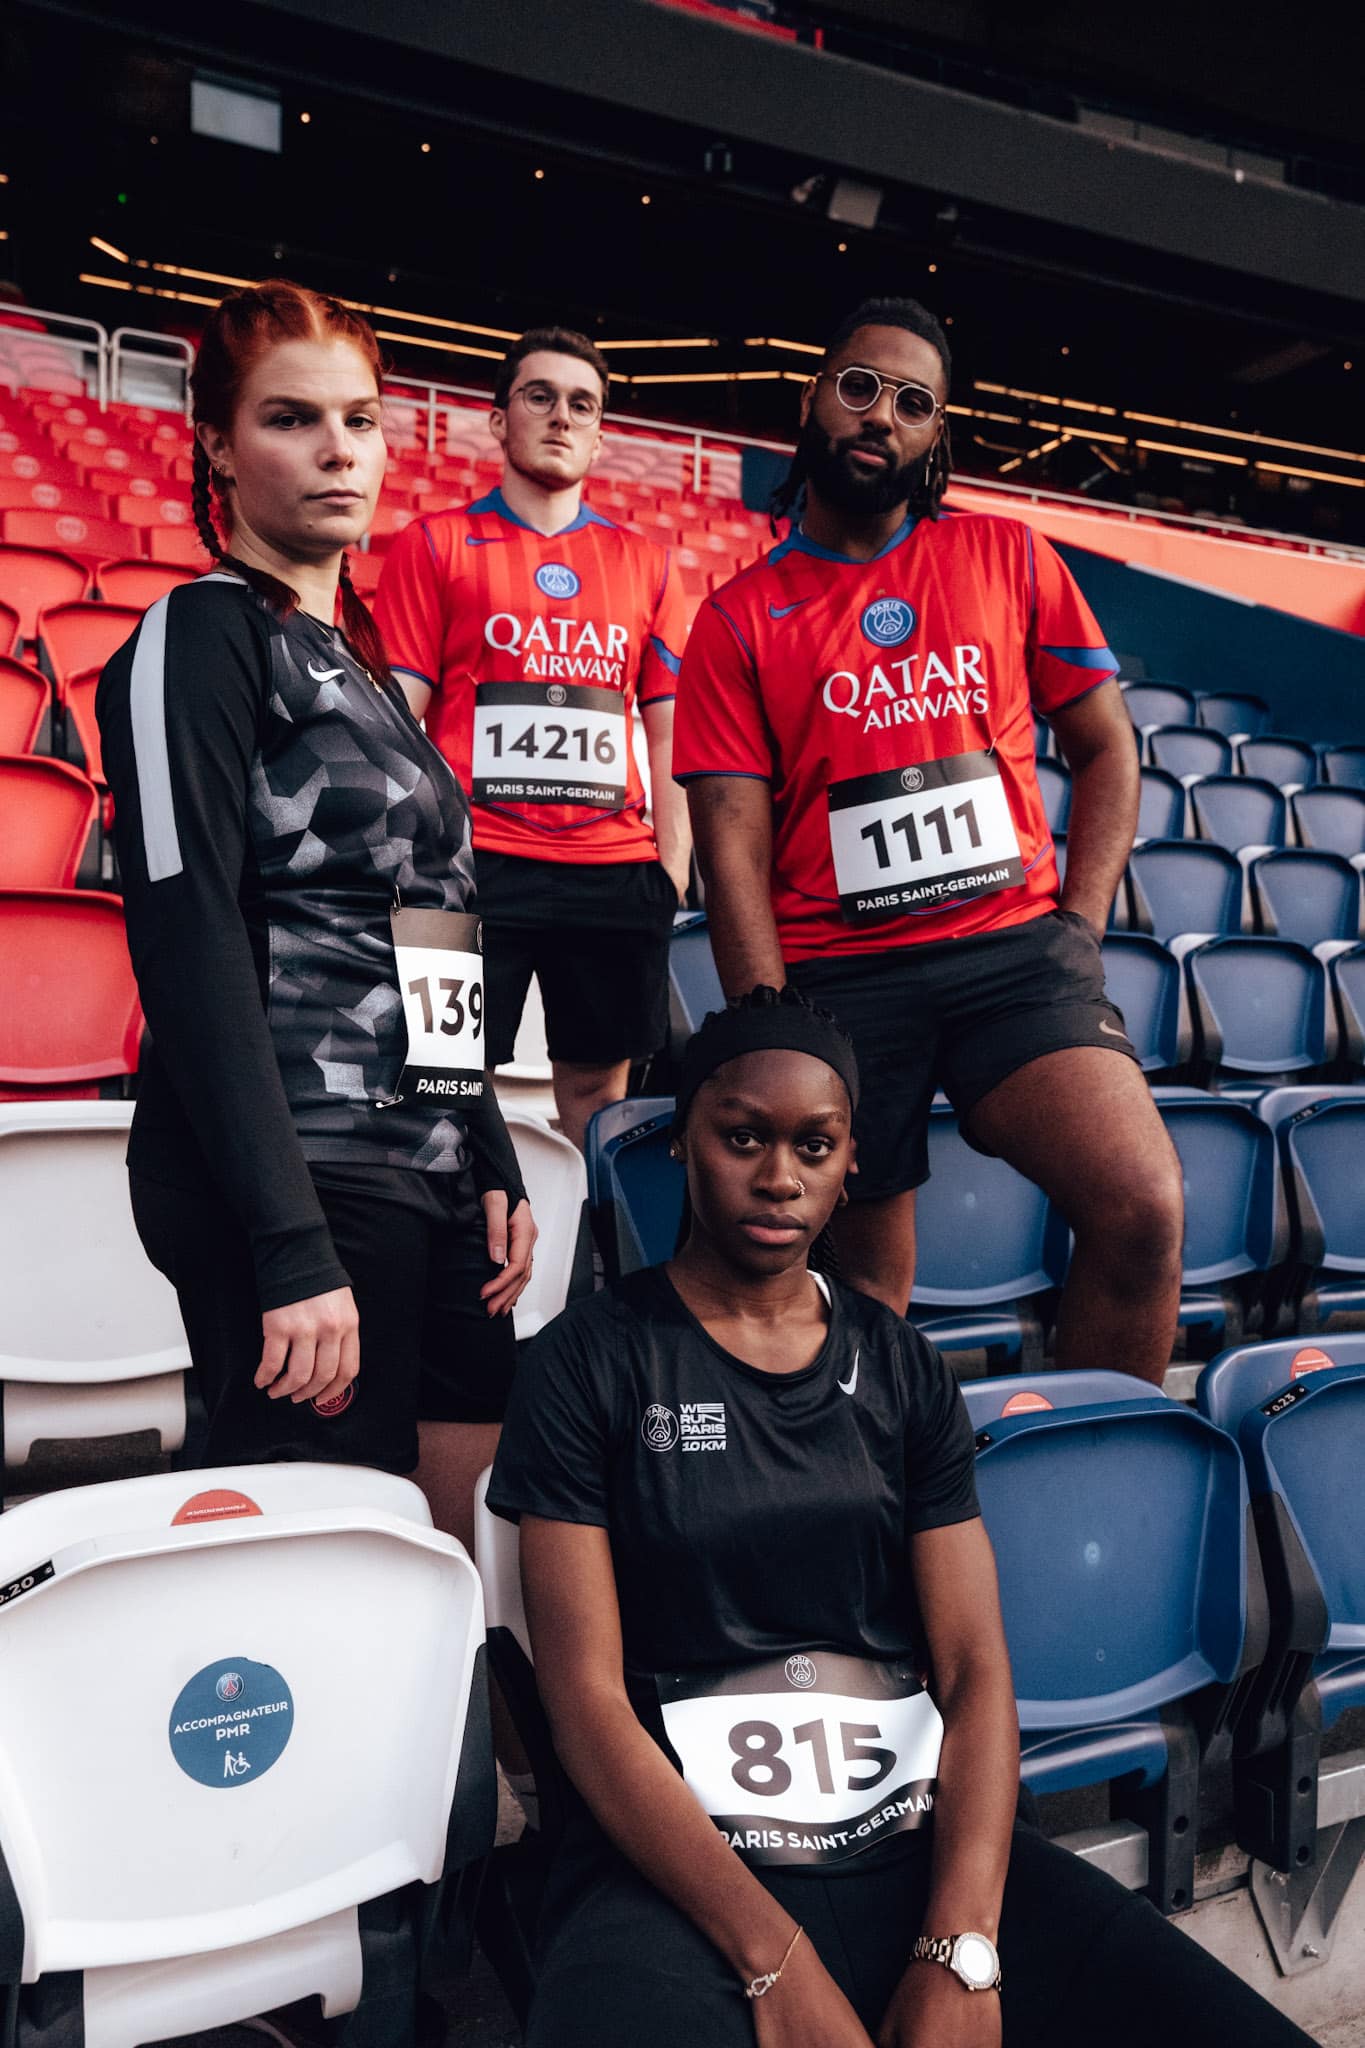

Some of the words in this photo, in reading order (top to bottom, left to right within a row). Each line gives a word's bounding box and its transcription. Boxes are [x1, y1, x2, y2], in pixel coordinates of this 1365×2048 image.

[484, 613, 628, 662] QATAR
[523, 652, 623, 686] AIRWAYS
[822, 645, 987, 718] QATAR
[863, 688, 989, 734] AIRWAYS
[485, 722, 616, 764] 14216
[486, 784, 525, 795] PARIS
[526, 784, 616, 801] SAINT-GERMAIN
[860, 799, 982, 869] 1111
[856, 893, 900, 911] PARIS
[902, 868, 1010, 903] SAINT-GERMAIN
[408, 976, 482, 1040] 139
[416, 1078, 459, 1095] PARIS
[680, 1403, 725, 1413] WE
[680, 1413, 725, 1424] RUN
[680, 1424, 726, 1435] PARIS
[174, 1701, 289, 1734] ACCOMPAGNATEUR
[215, 1723, 250, 1741] PMR
[728, 1718, 898, 1797] 815
